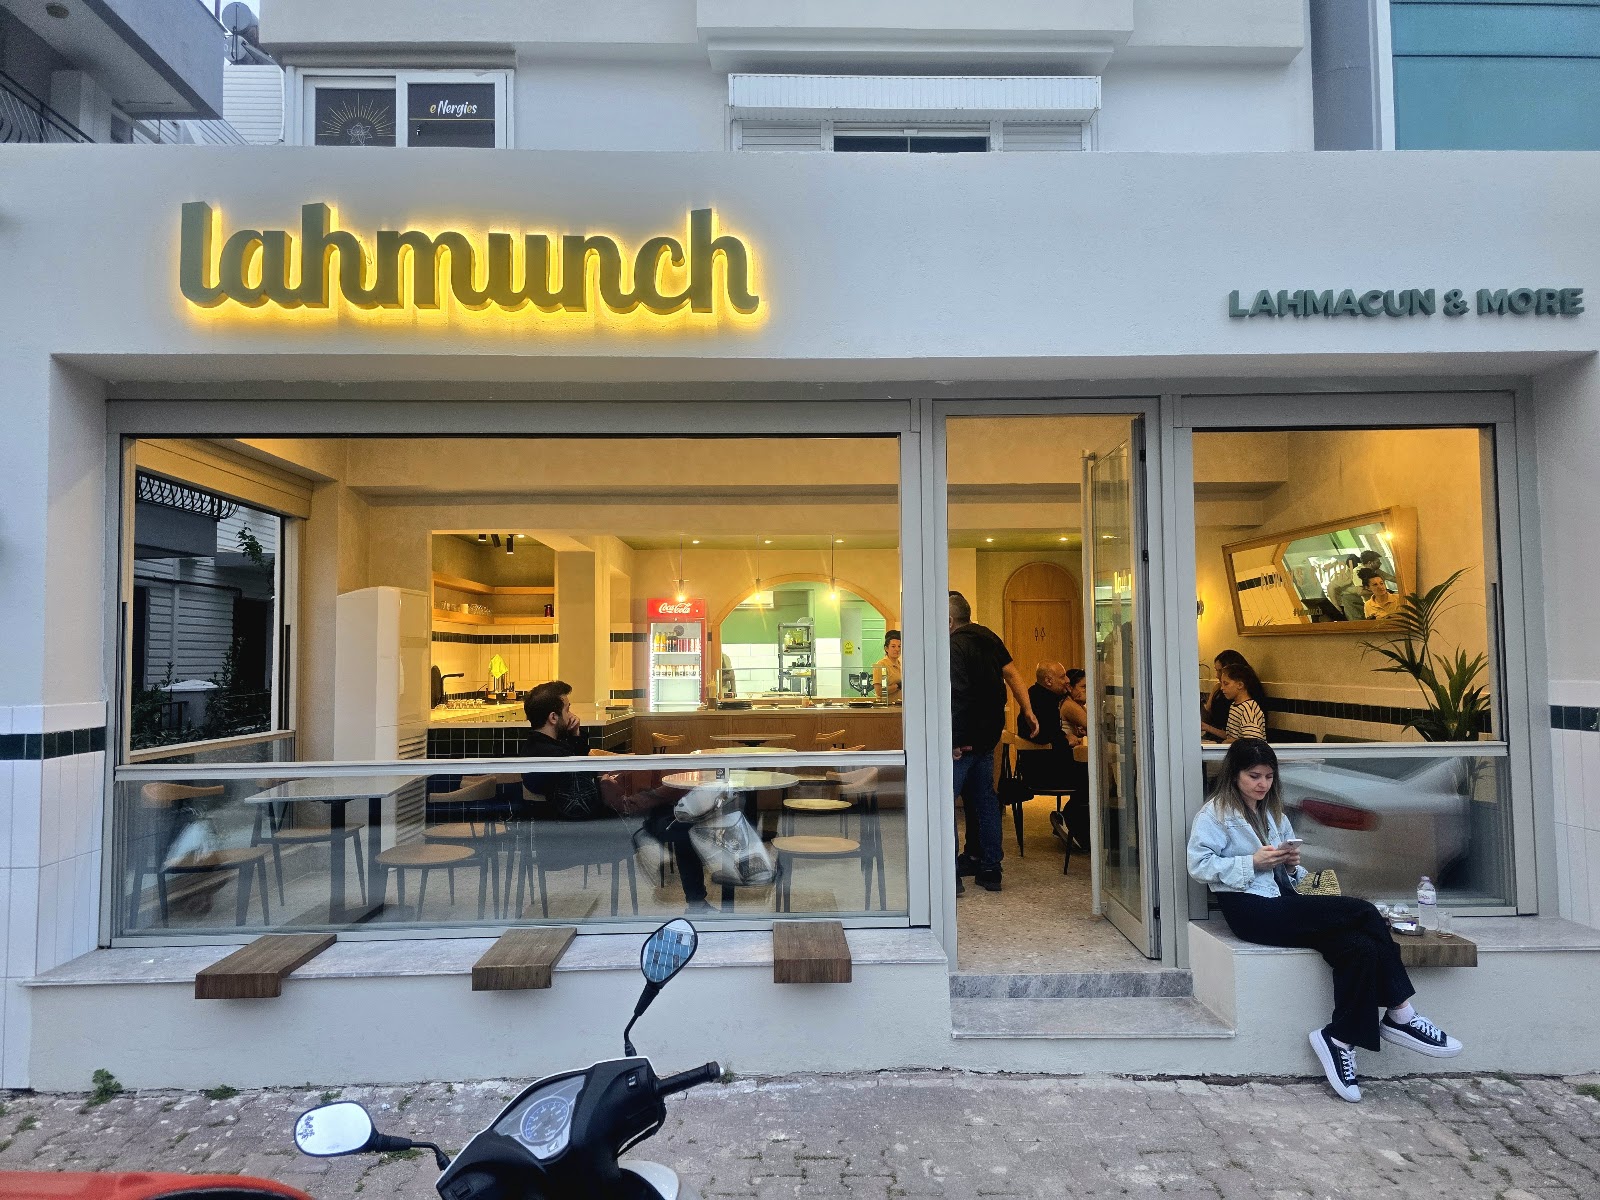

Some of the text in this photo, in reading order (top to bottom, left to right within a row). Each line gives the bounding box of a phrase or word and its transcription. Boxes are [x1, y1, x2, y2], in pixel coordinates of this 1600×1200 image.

[429, 99, 477, 117] eNergies
[180, 202, 760, 315] lahmunch
[1228, 287, 1585, 318] LAHMACUN & MORE
